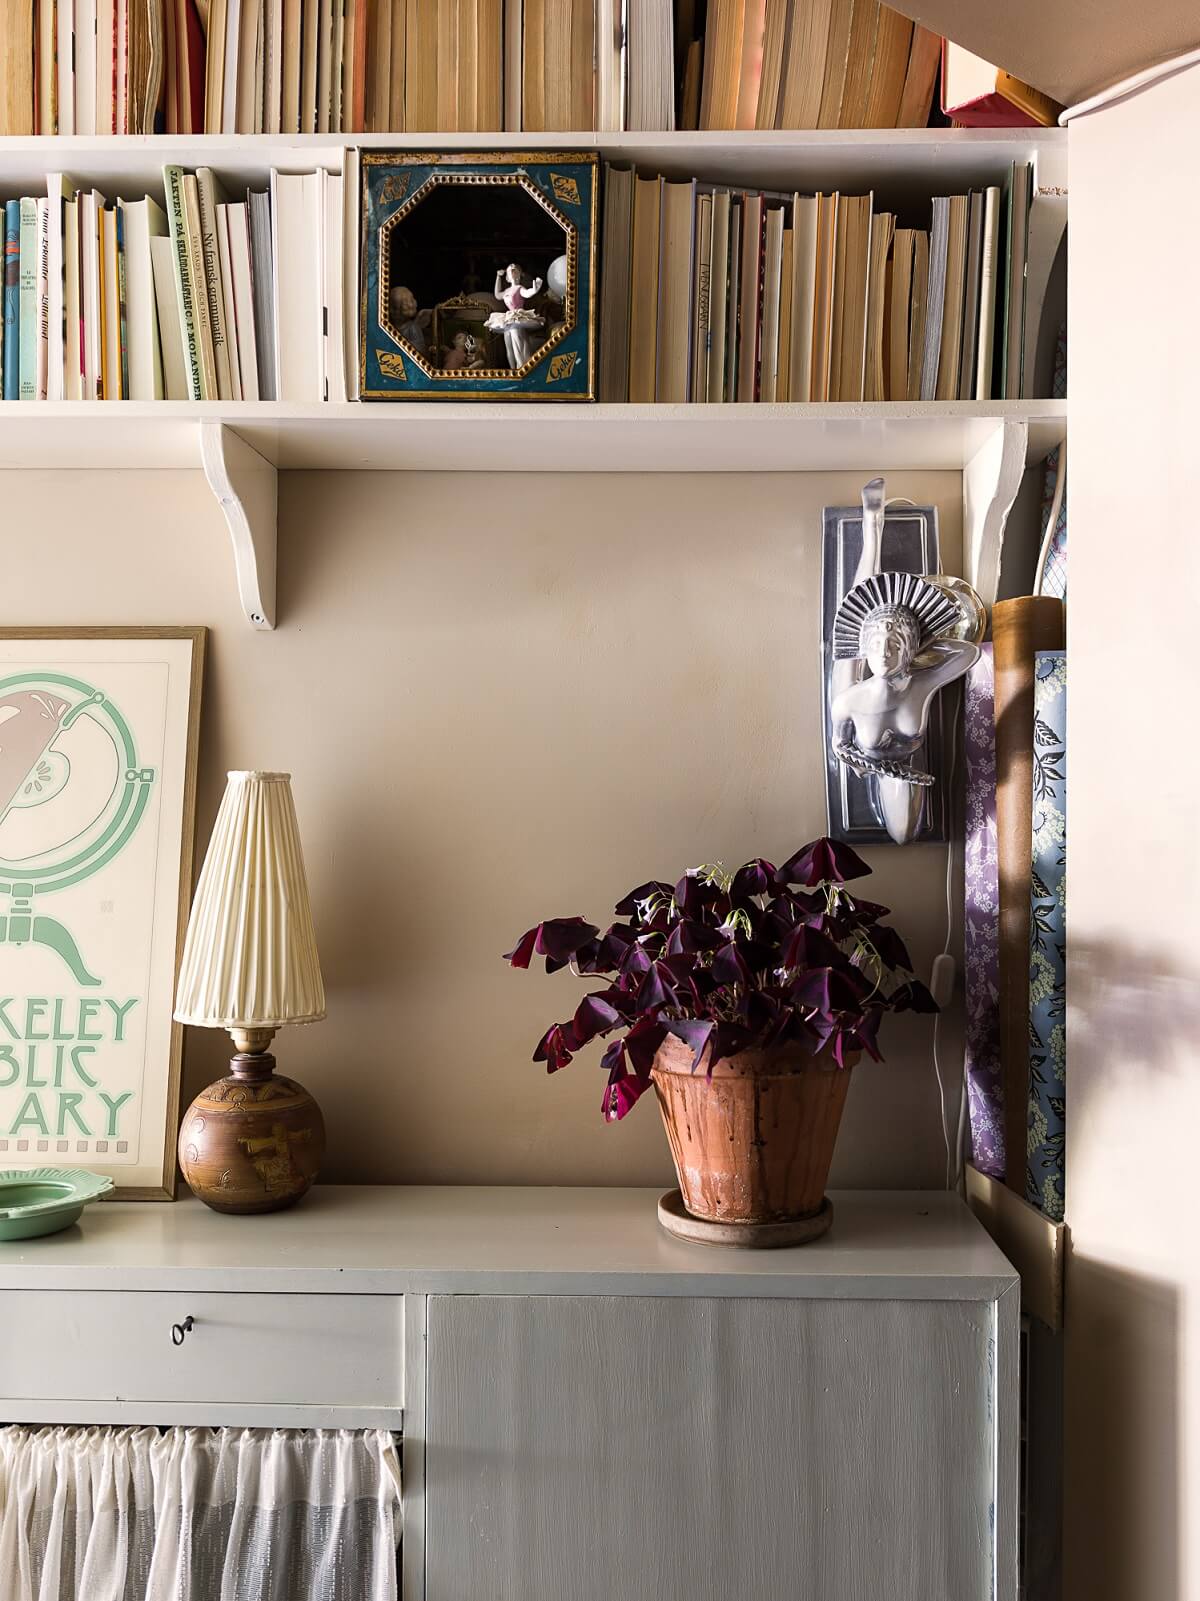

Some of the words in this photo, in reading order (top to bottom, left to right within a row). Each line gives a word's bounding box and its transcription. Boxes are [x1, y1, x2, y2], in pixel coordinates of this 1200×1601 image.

[170, 170, 182, 218] JAKTEN
[175, 222, 186, 237] PÅ
[203, 232, 213, 248] Ny
[205, 250, 218, 285] fransk
[208, 287, 224, 347] grammatik
[188, 333, 202, 400] MOLANDER
